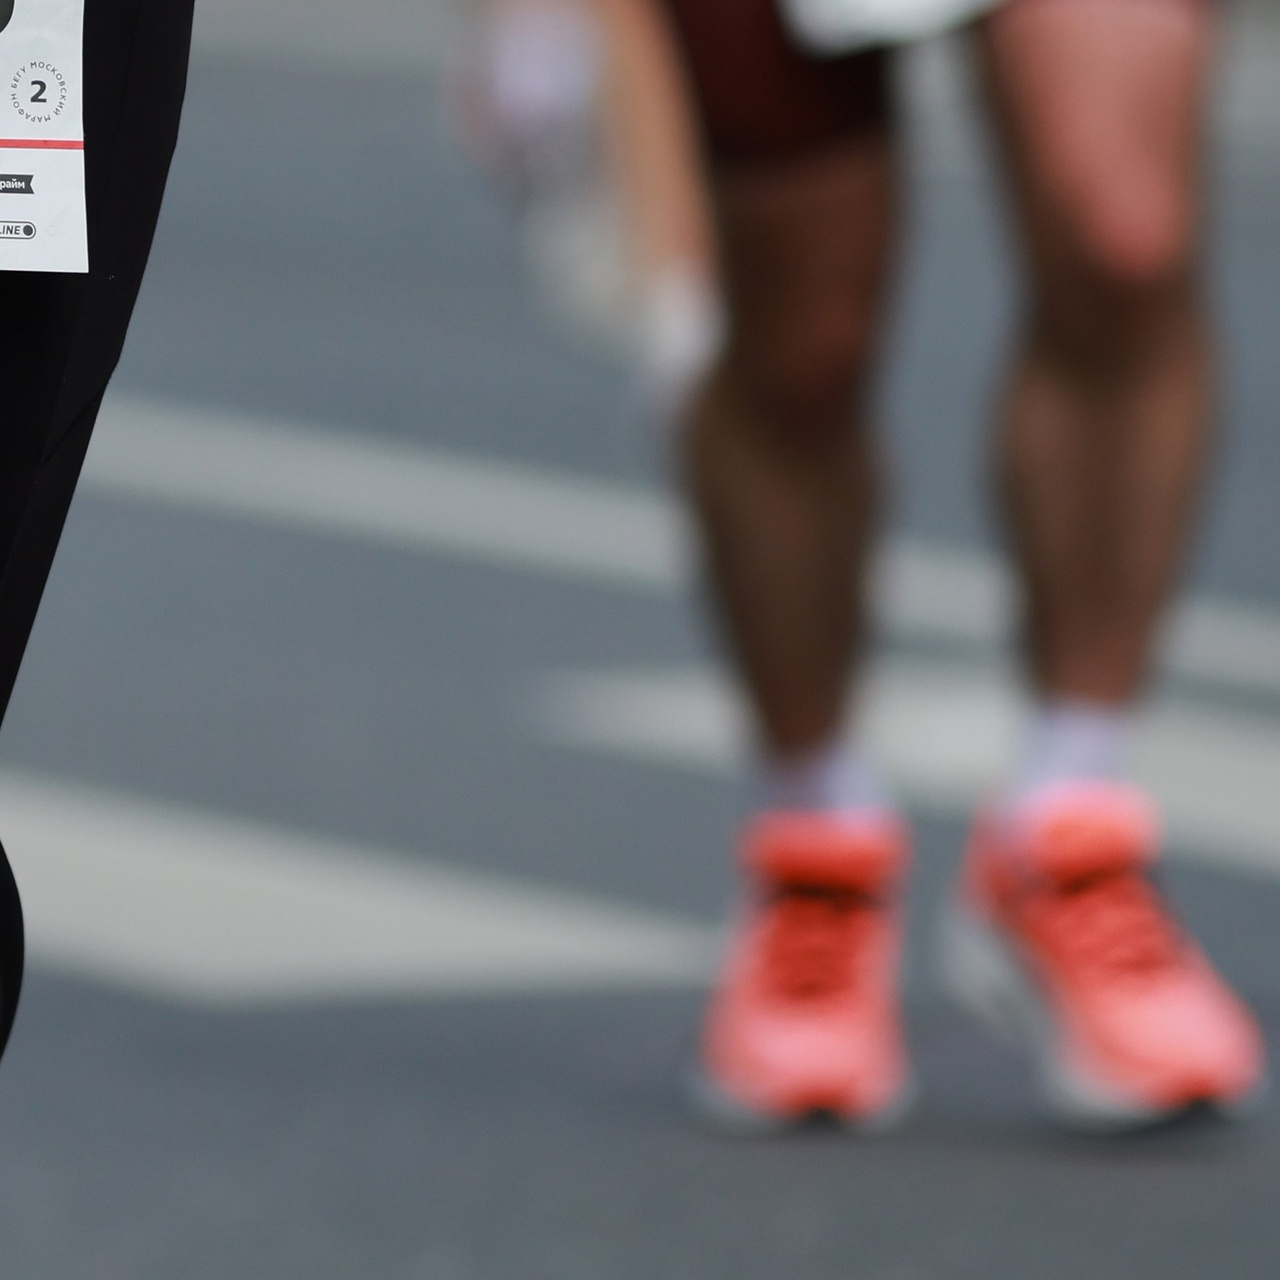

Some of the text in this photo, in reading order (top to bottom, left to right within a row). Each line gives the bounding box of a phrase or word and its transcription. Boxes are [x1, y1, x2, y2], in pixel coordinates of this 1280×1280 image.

[10, 61, 67, 123] БЕГУ МОСКОВСКИЙ МАРАФОН
[30, 80, 47, 103] 2
